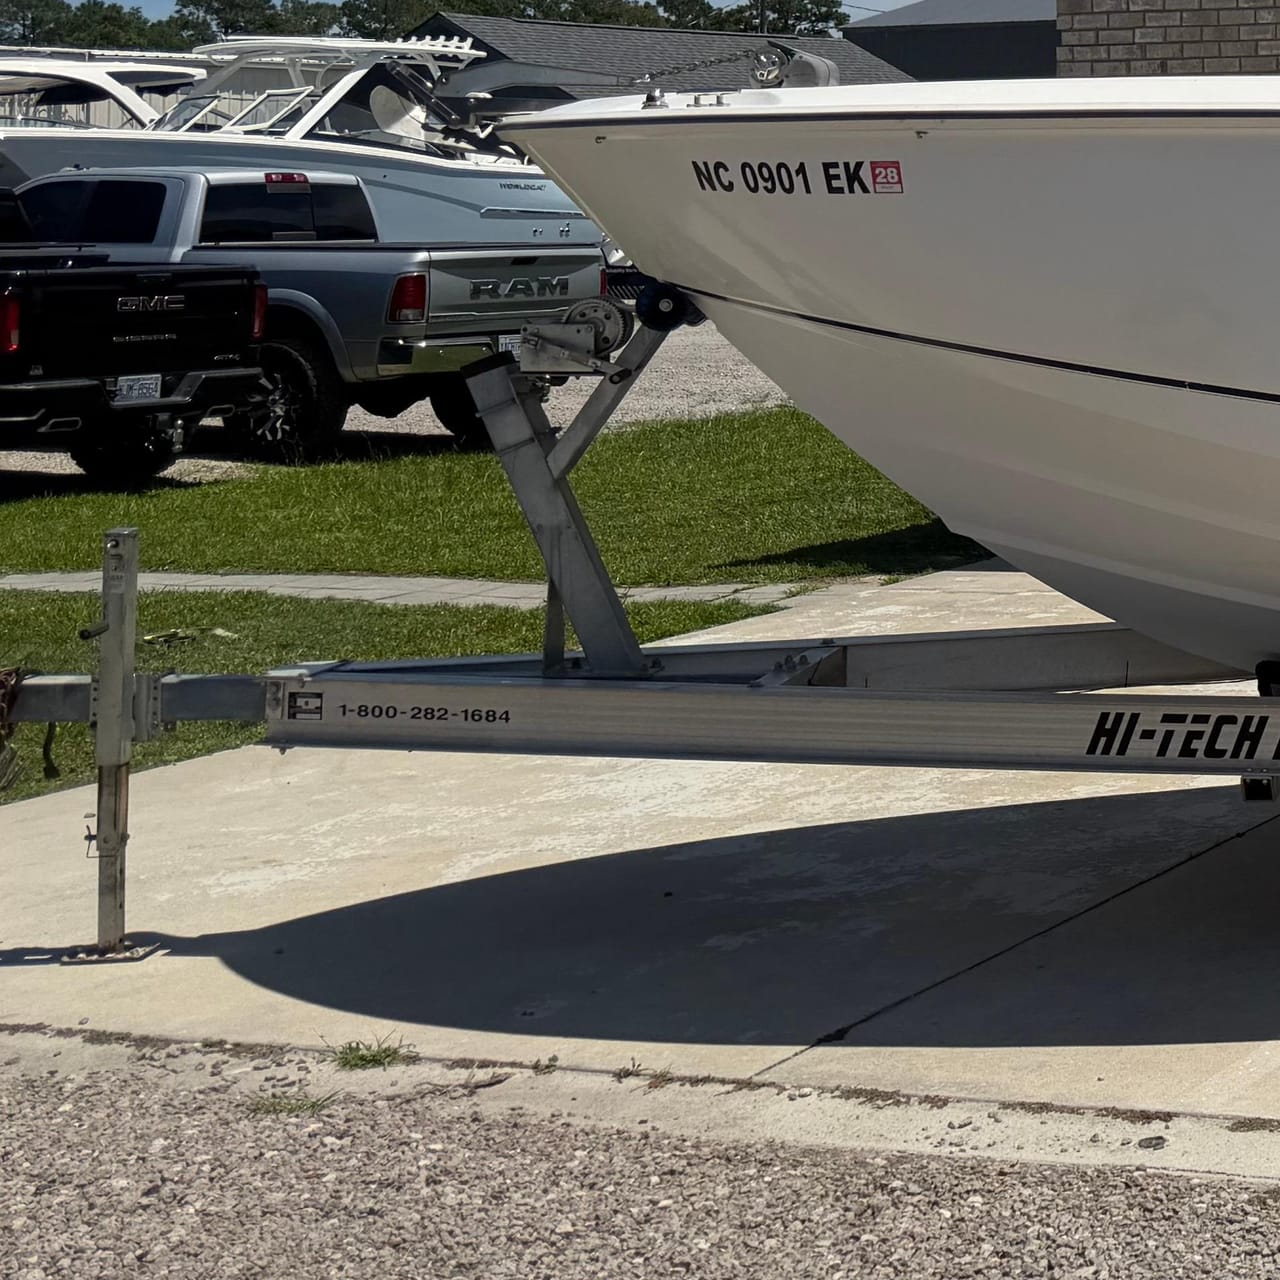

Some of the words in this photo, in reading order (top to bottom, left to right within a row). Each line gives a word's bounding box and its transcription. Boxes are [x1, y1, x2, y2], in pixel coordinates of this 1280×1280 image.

[692, 160, 735, 192] NC
[740, 161, 812, 194] 0901
[821, 161, 871, 194] EK
[875, 167, 899, 183] 28
[470, 275, 569, 300] RAM
[117, 294, 185, 312] GMC
[338, 704, 511, 724] 1-800-282-1684
[1085, 711, 1270, 760] HI-TECH
